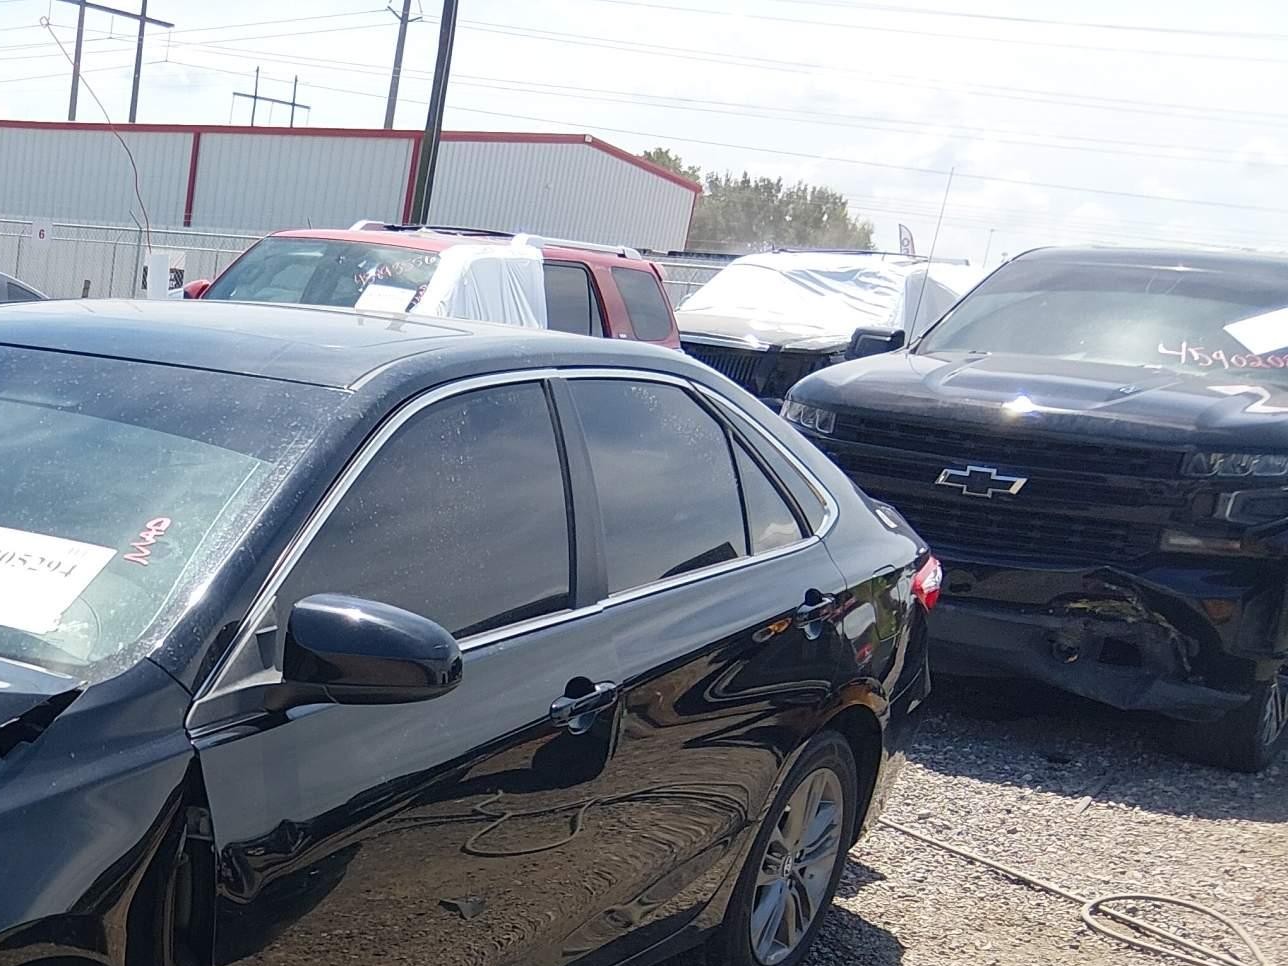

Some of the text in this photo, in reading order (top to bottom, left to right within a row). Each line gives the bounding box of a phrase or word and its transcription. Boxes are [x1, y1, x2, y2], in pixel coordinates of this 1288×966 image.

[38, 228, 45, 240] 6
[1158, 341, 1288, 370] 459020
[123, 517, 172, 566] MAD
